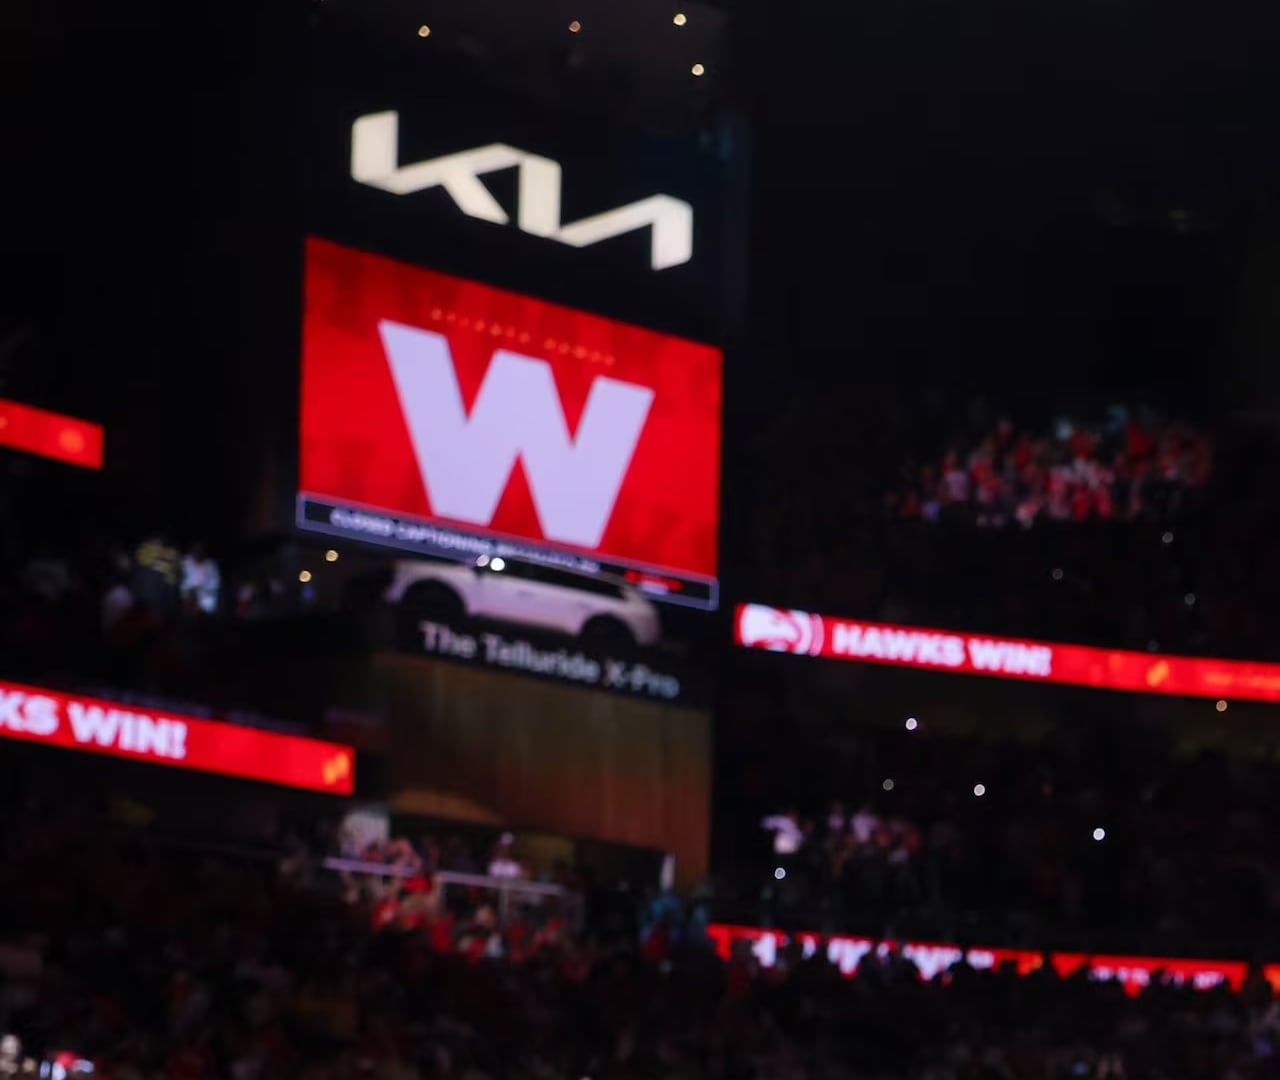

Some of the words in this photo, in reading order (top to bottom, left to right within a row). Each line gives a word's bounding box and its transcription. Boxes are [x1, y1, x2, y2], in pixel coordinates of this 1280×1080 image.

[378, 319, 655, 548] W
[419, 620, 478, 659] The
[481, 633, 600, 684] Telluride
[832, 622, 964, 668] HAWKS
[967, 640, 1053, 677] WIN!
[67, 701, 188, 760] WIN!
